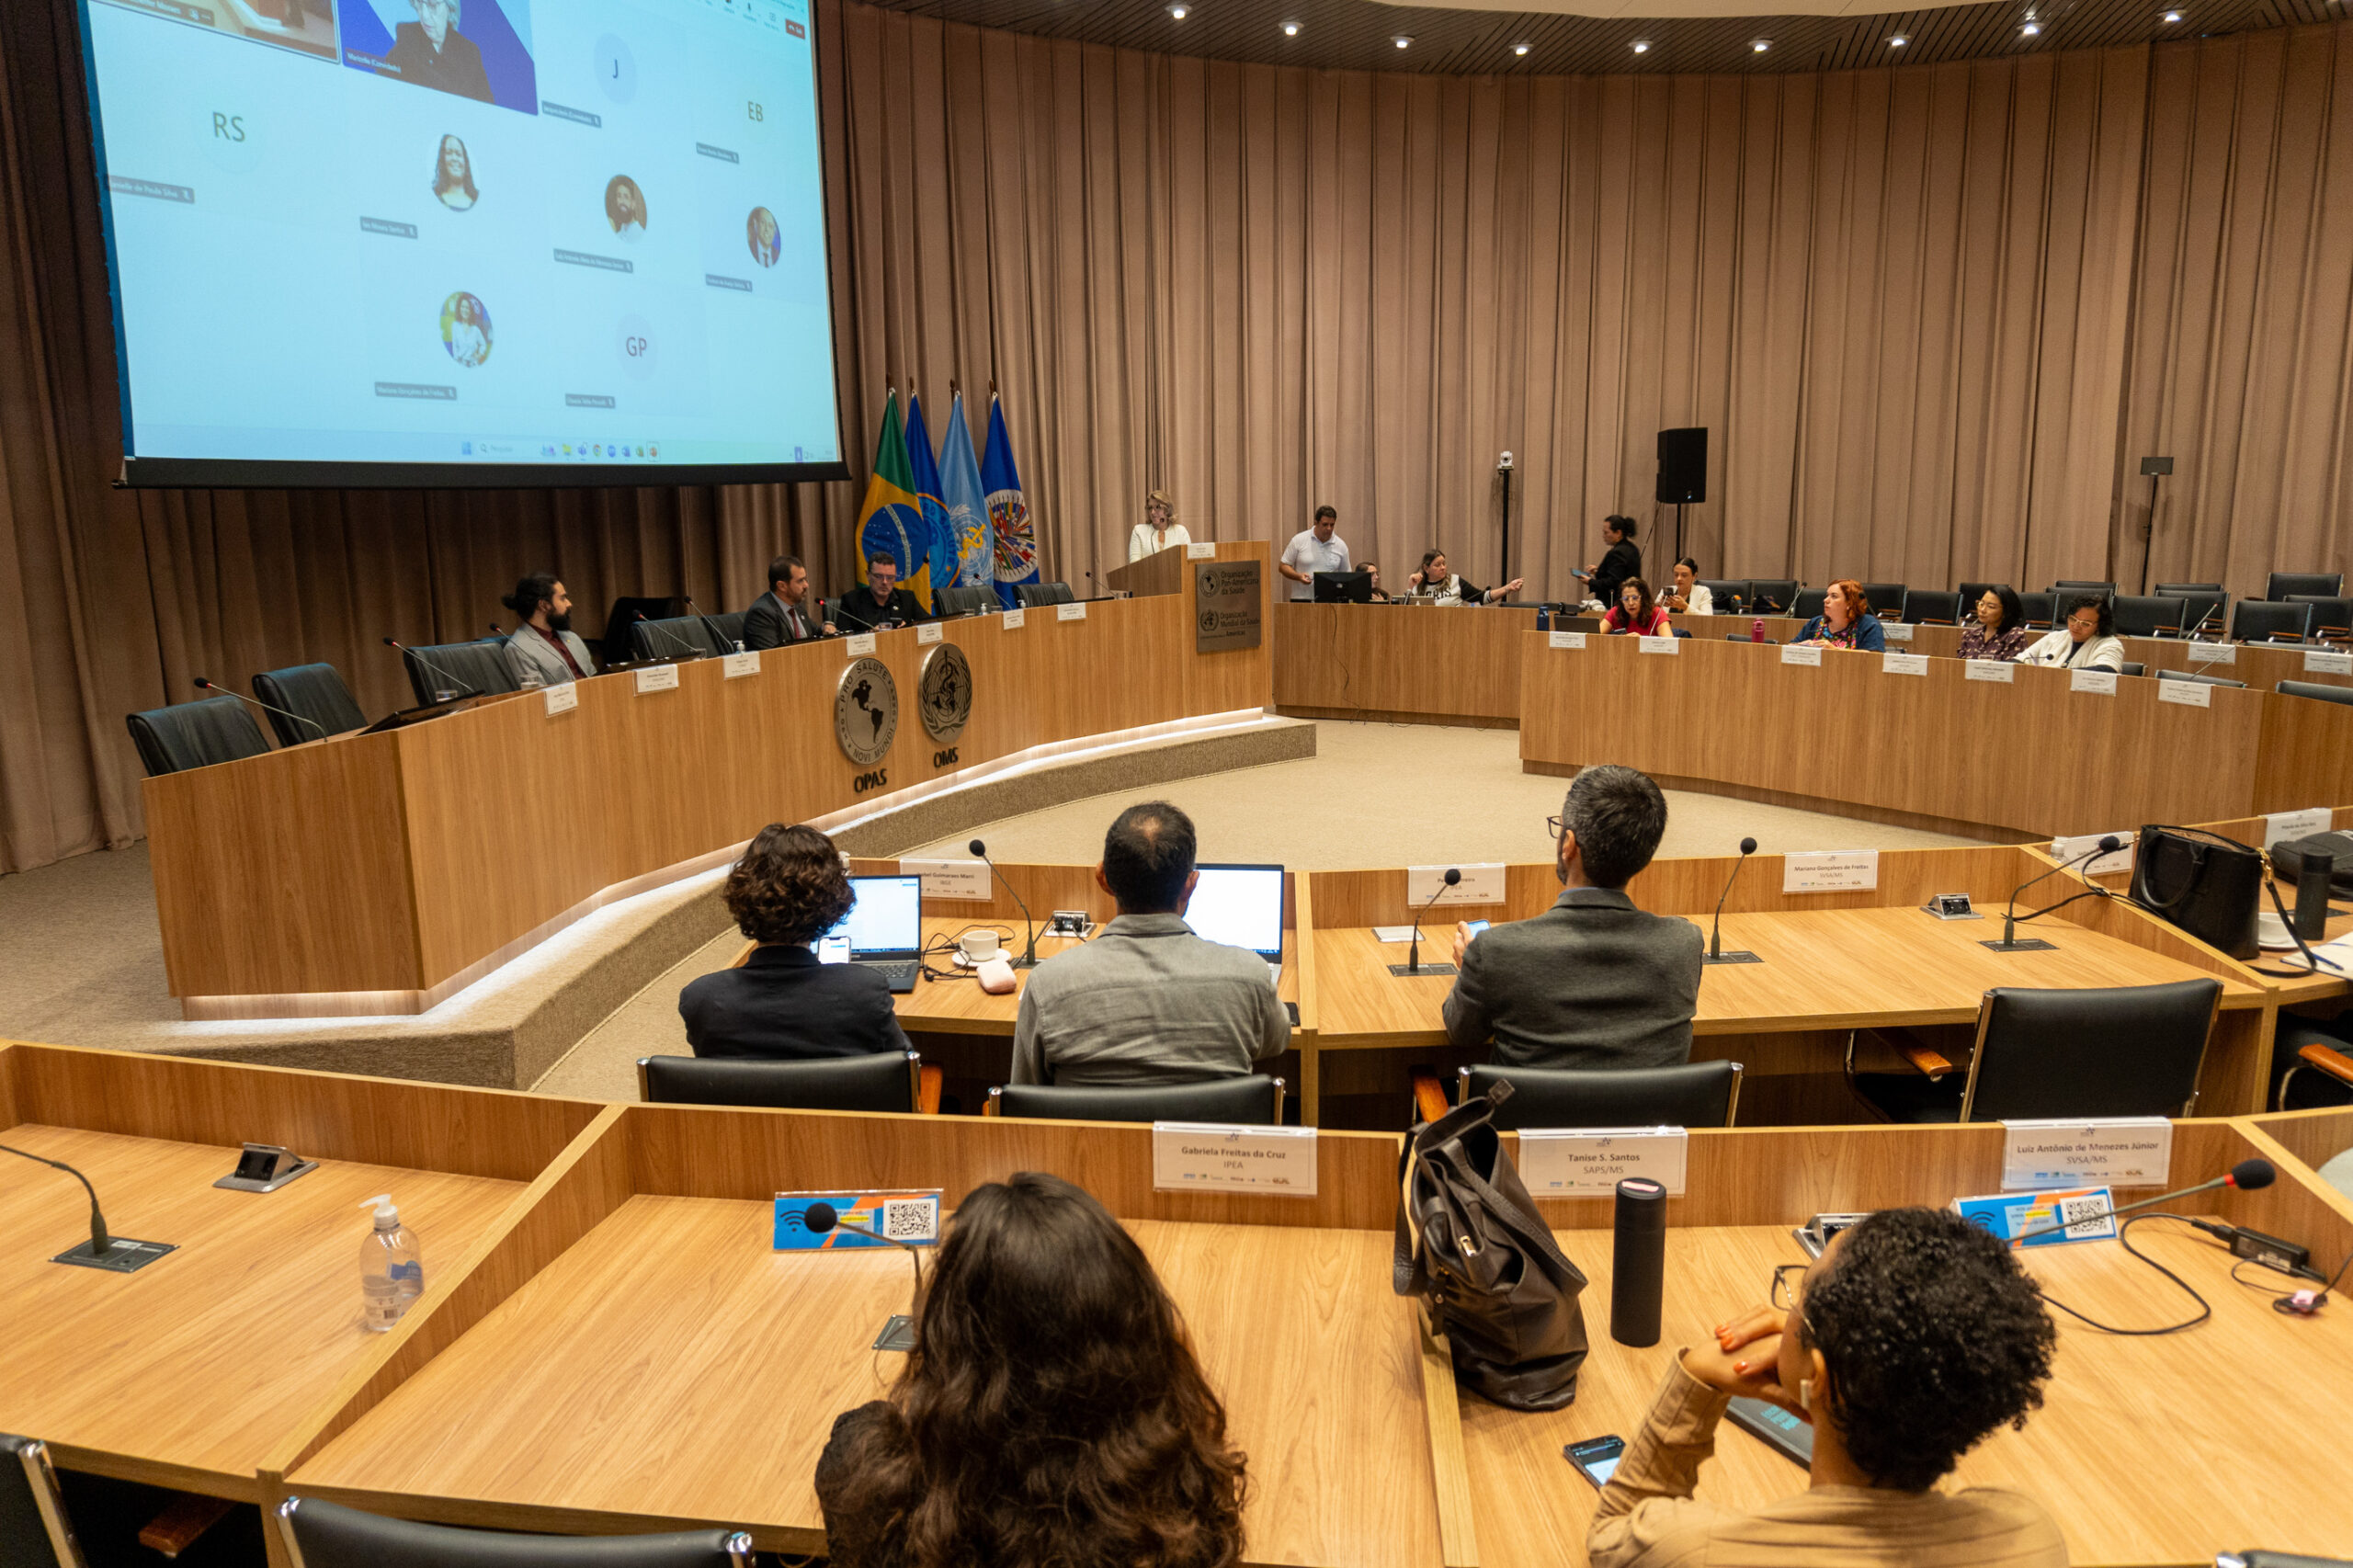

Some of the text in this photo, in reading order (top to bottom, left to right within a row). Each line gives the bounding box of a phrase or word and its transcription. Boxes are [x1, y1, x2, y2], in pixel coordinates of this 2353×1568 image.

[612, 58, 620, 79] J
[747, 99, 764, 122] EB
[212, 111, 246, 142] RS
[626, 335, 648, 358] GP
[840, 662, 888, 703] PRO SALUTE
[853, 727, 894, 762] NOVI MUNDI
[933, 747, 959, 768] OMS
[854, 768, 887, 793] OPAS
[1181, 1146, 1286, 1160] Gabriela Freitas da Cruz
[2017, 1145, 2034, 1153] Luiz
[2075, 1143, 2086, 1152] de
[2088, 1142, 2129, 1152] Menezes
[2131, 1141, 2159, 1151] Júnior
[1223, 1161, 1244, 1169] IPEA
[1568, 1153, 1641, 1163] Tanise S. Santos
[2066, 1155, 2108, 1165] SVSA/MS
[1583, 1165, 1624, 1175] SAPS/MS
